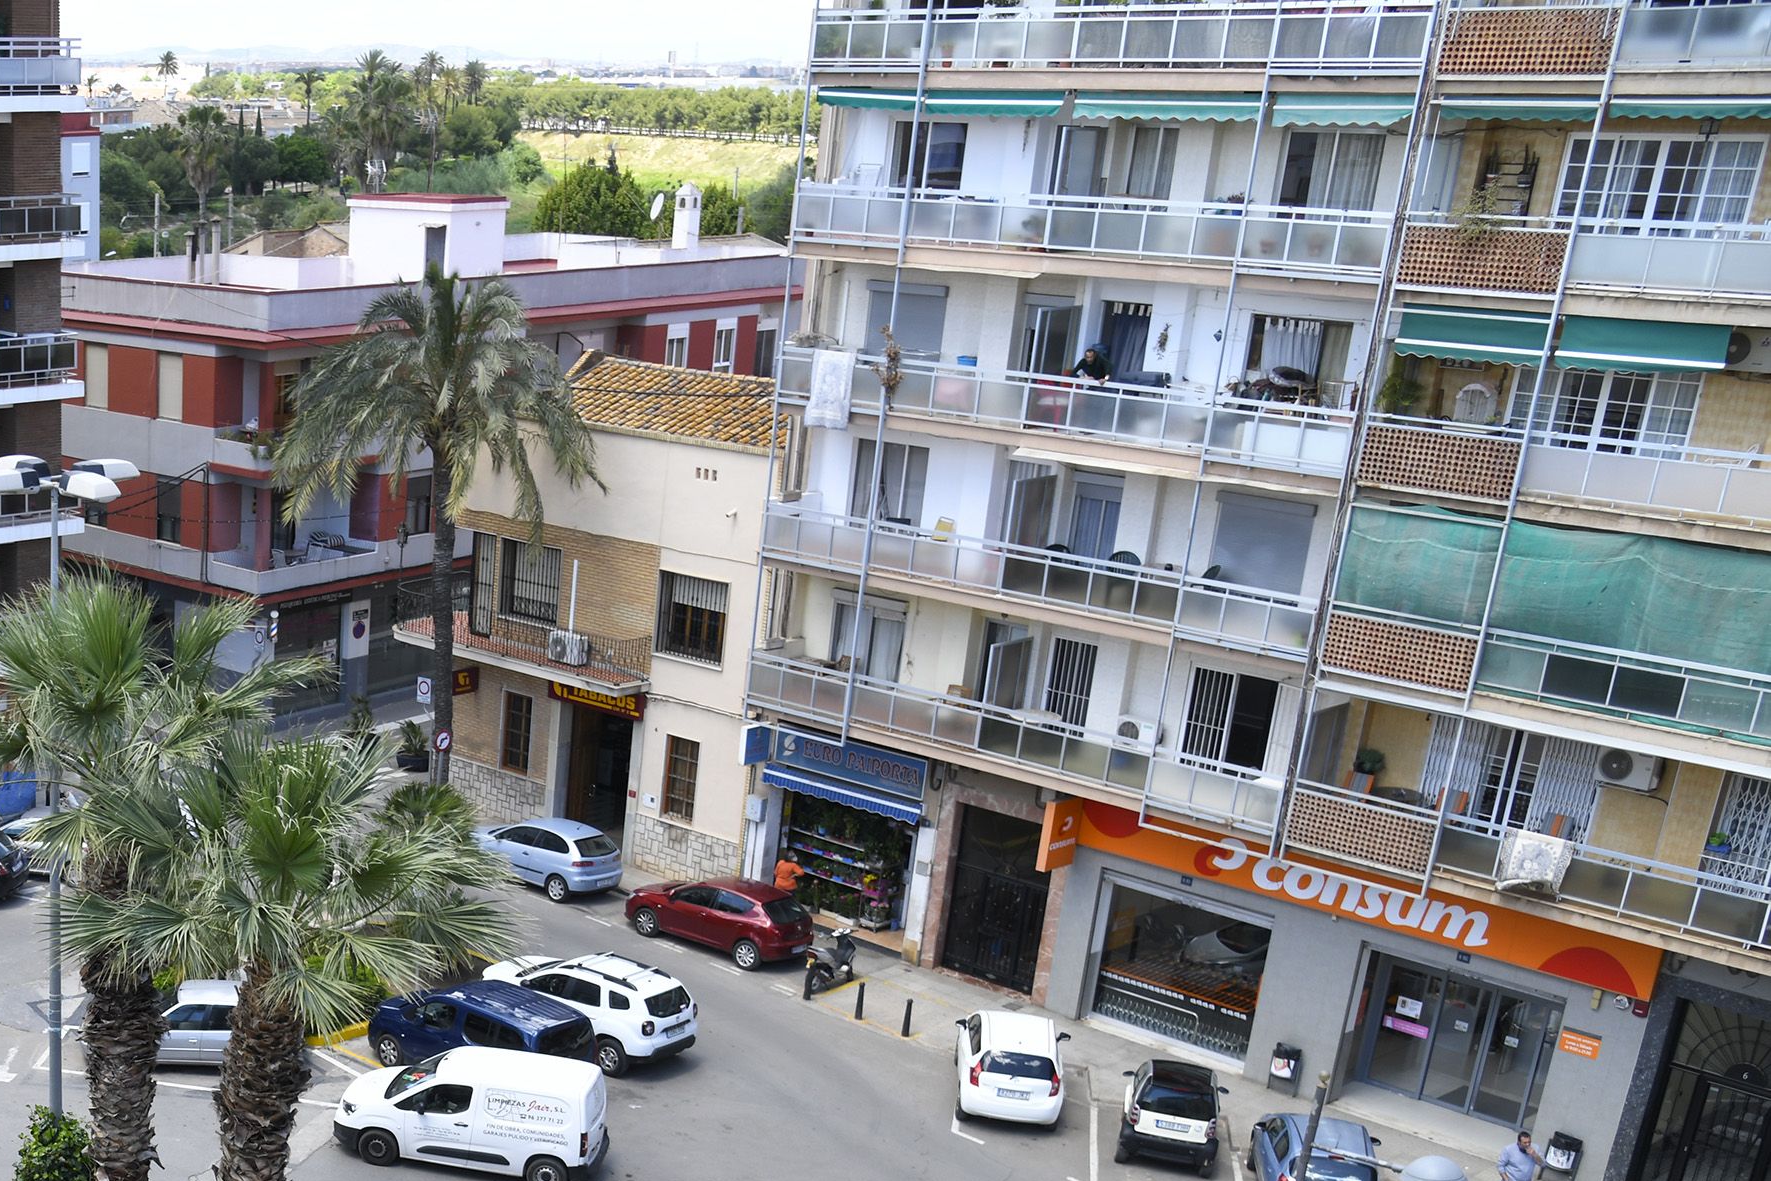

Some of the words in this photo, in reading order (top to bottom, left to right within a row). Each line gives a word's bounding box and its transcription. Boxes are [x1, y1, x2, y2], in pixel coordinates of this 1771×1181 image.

[573, 687, 636, 710] TABACOS
[802, 740, 843, 765] EURO
[846, 752, 920, 786] PAIPORTA
[1252, 857, 1489, 947] consum
[1742, 1071, 1749, 1080] 6
[487, 1097, 526, 1107] LIMPIEZAS
[482, 1130, 507, 1138] GARAJES
[508, 1133, 528, 1141] PULIDO
